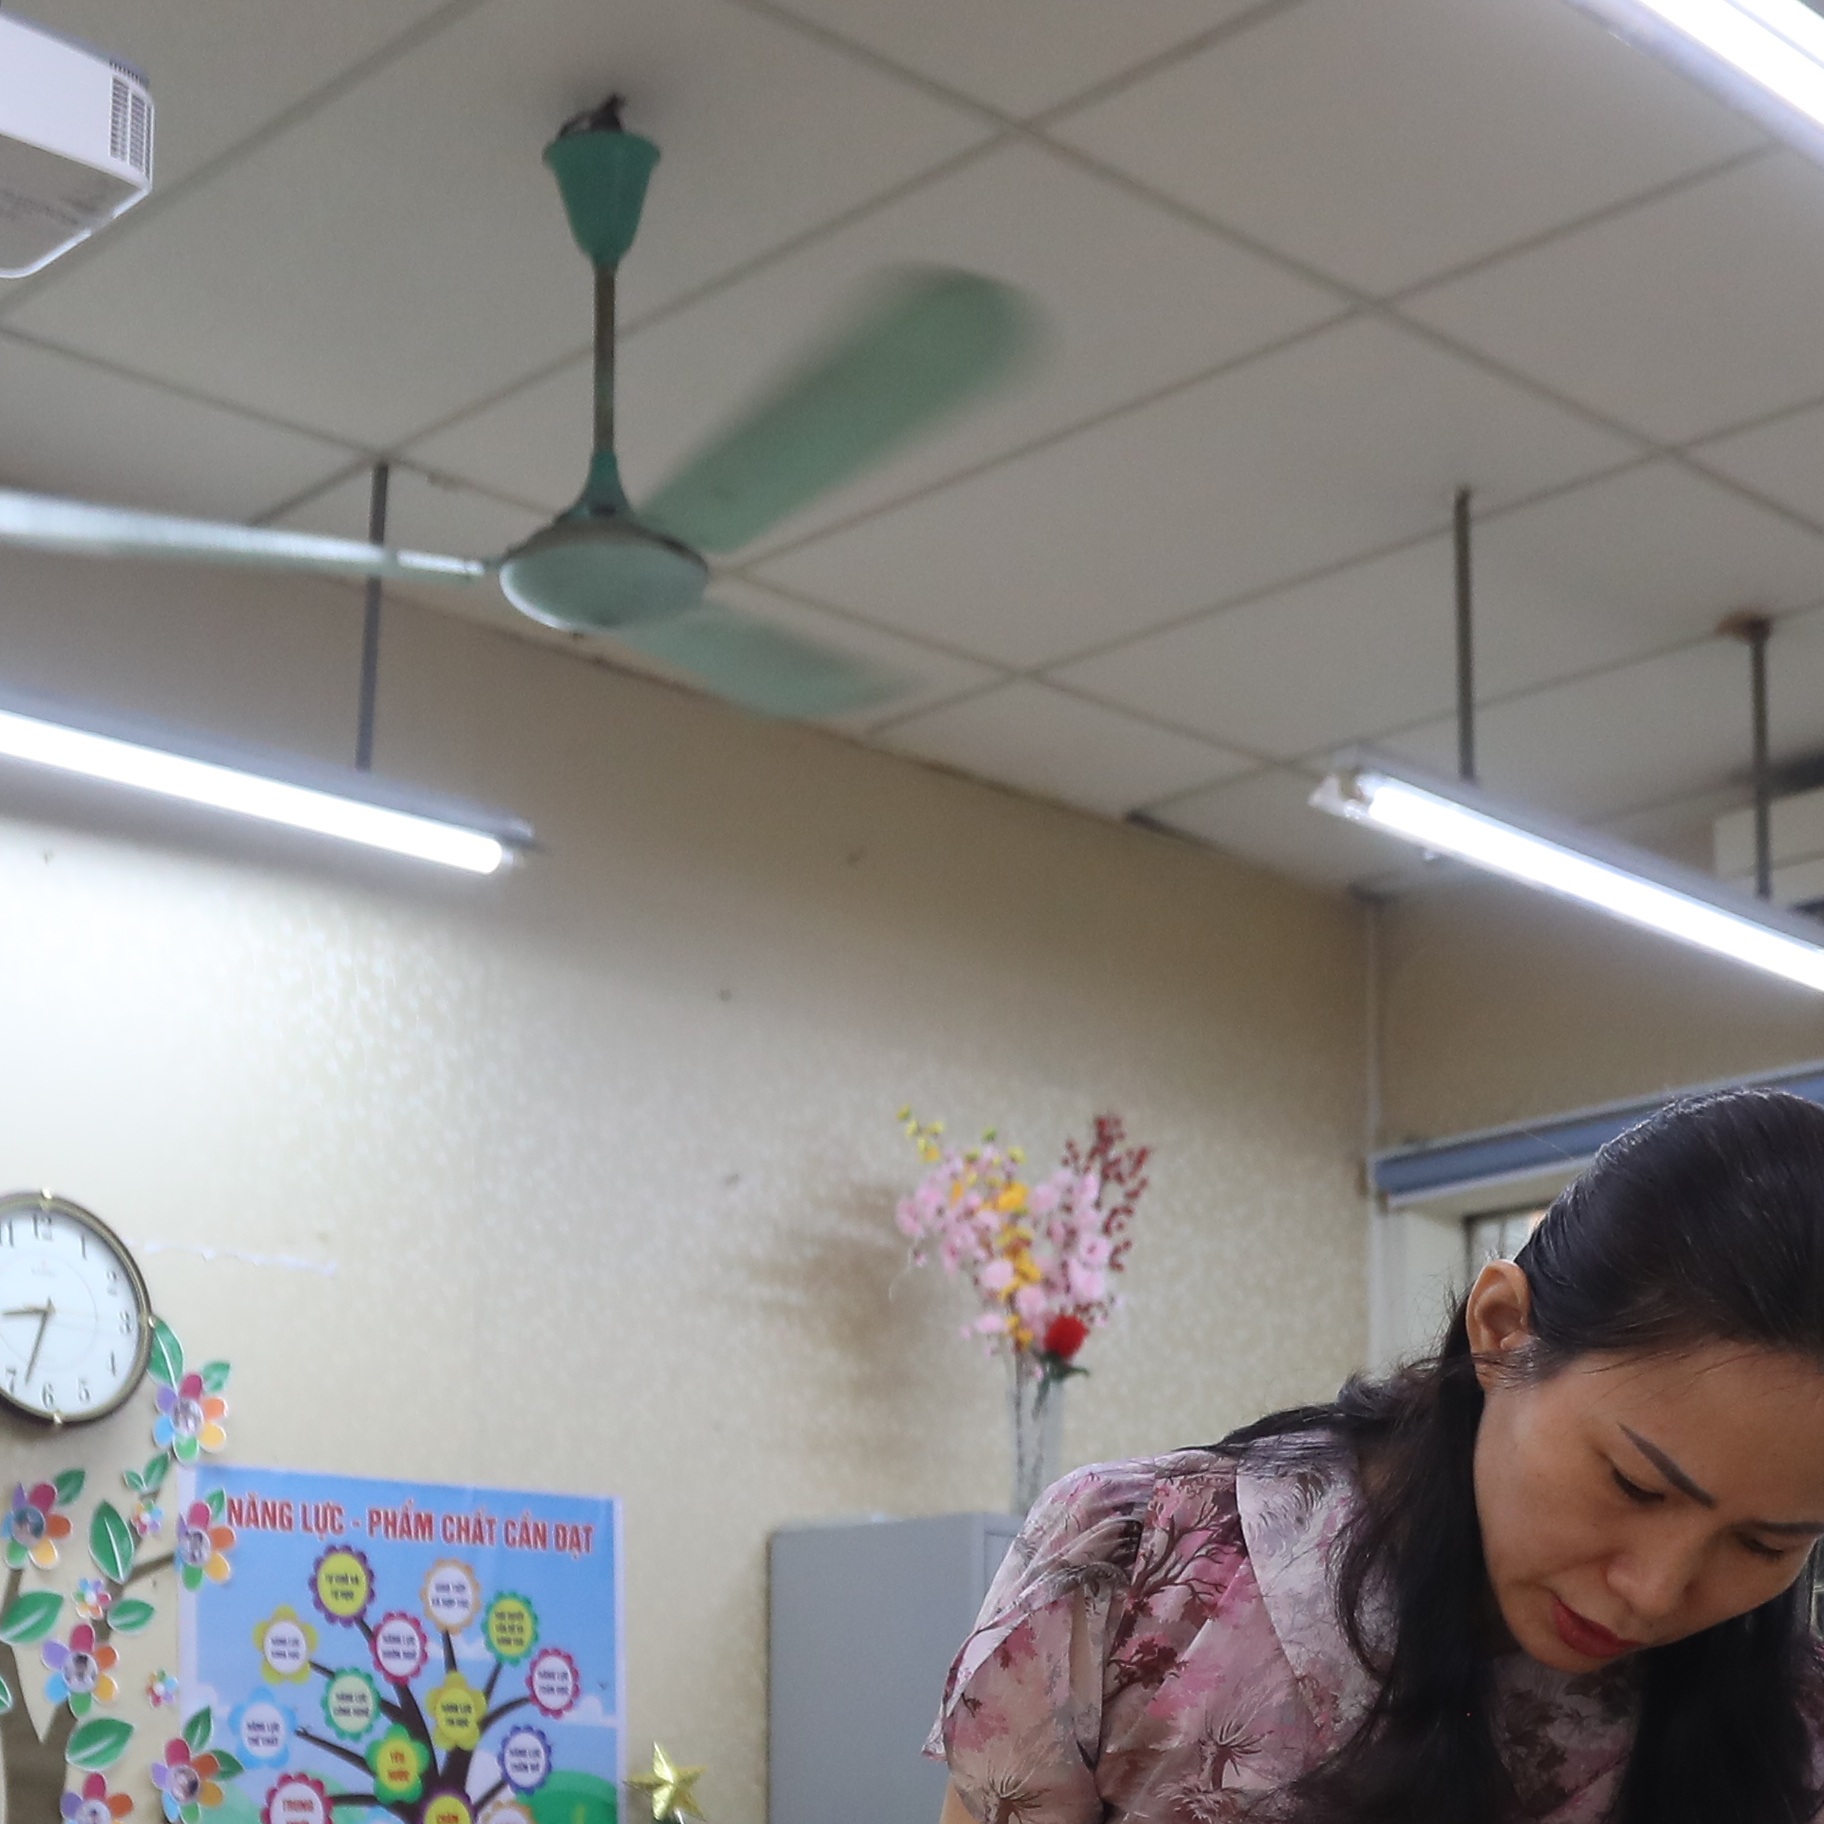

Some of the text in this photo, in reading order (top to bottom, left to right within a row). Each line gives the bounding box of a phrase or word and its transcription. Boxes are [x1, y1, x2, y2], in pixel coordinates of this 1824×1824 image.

[33, 1213, 53, 1242] 12
[106, 1270, 117, 1296] 2
[119, 1310, 131, 1335] 3
[5, 1367, 16, 1394] 7
[78, 1376, 90, 1402] 5
[42, 1382, 54, 1409] 6
[226, 1491, 294, 1532] NĂNG
[300, 1500, 344, 1541] LỰC
[366, 1499, 434, 1542] PHẨM
[441, 1510, 497, 1546] CHẤT
[503, 1510, 548, 1551] CẦN
[553, 1523, 594, 1559] ĐẠT
